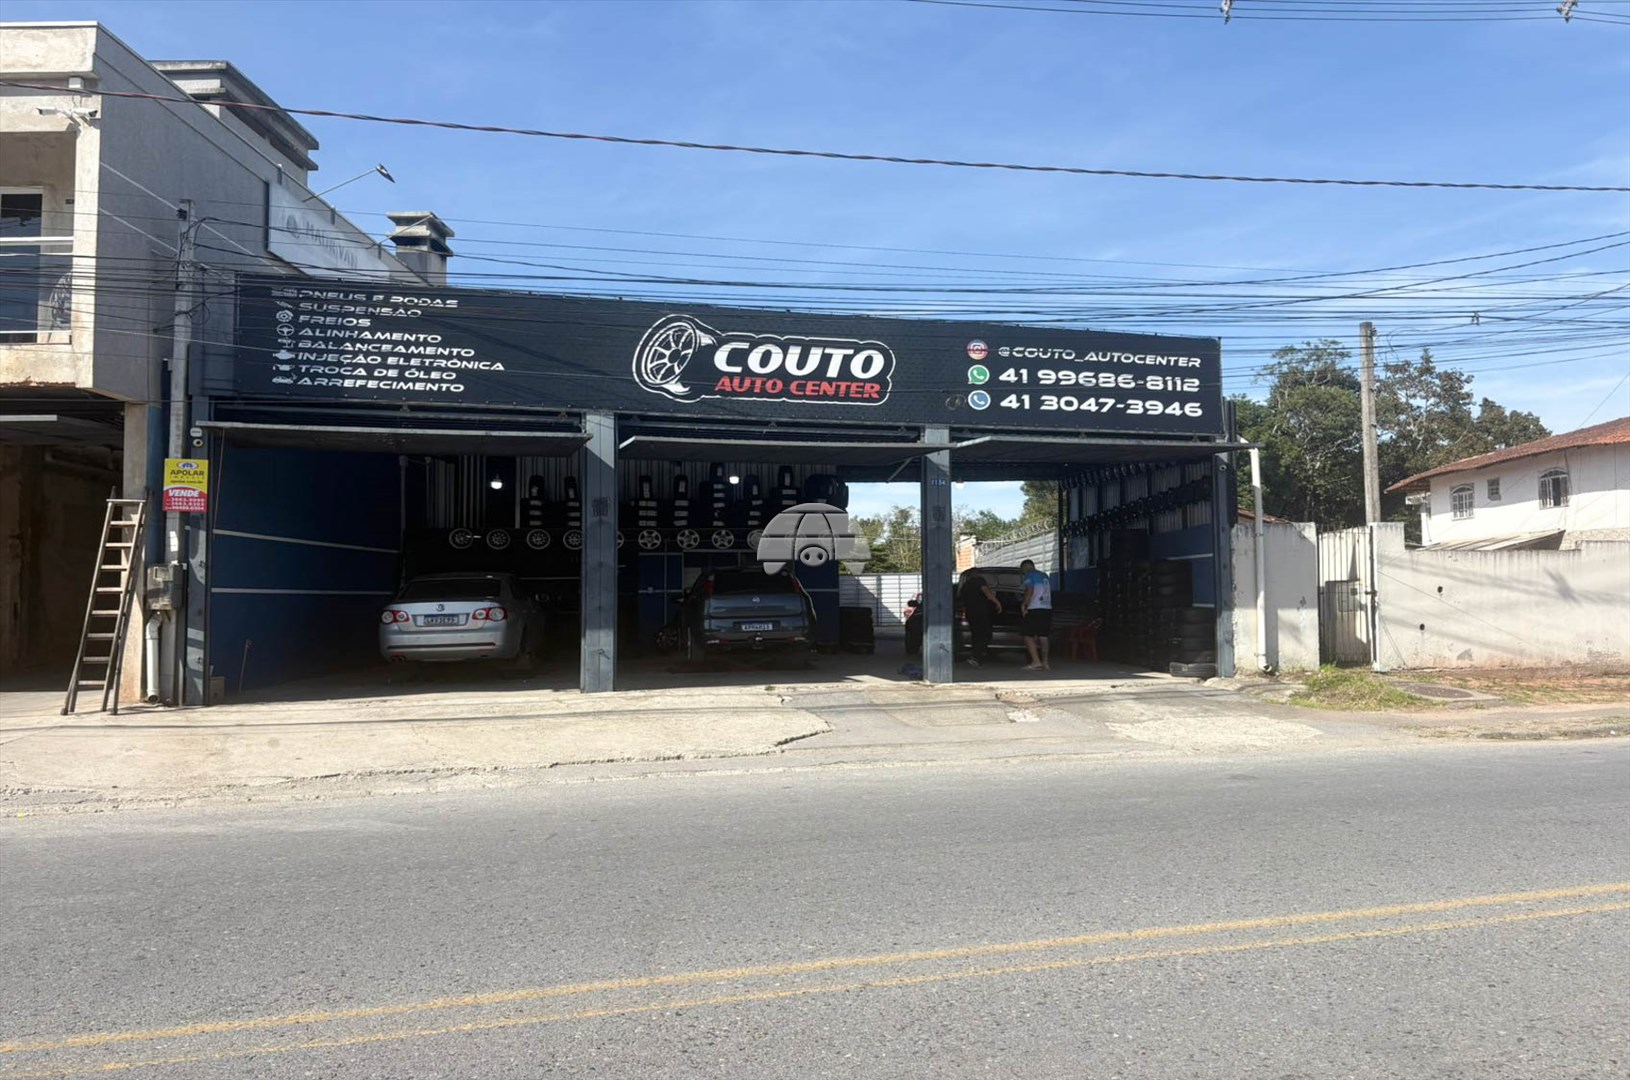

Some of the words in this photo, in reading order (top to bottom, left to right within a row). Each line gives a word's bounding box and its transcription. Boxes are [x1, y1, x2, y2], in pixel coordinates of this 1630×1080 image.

[299, 315, 372, 327] FREIOS
[298, 327, 442, 343] ALINHAMENTO
[298, 339, 475, 357] BALANCEAMENTO
[998, 346, 1202, 368] @COUTO_AUTOCENTER
[297, 352, 382, 365] INJEÇÃO
[386, 357, 505, 371] ELETRÔNICA
[713, 341, 886, 379] COUTO
[299, 364, 368, 376] TROCA
[373, 368, 399, 377] DE
[404, 367, 457, 380] ÓLEO
[998, 367, 1029, 384] 41
[1037, 368, 1201, 393] 99686-8112
[297, 376, 465, 393] ARREFECIMENTO
[714, 375, 784, 394] AUTO
[789, 380, 882, 399] CENTER
[999, 393, 1031, 410] 41
[1039, 394, 1204, 417] 3047-3946
[168, 489, 200, 497] VENDE
